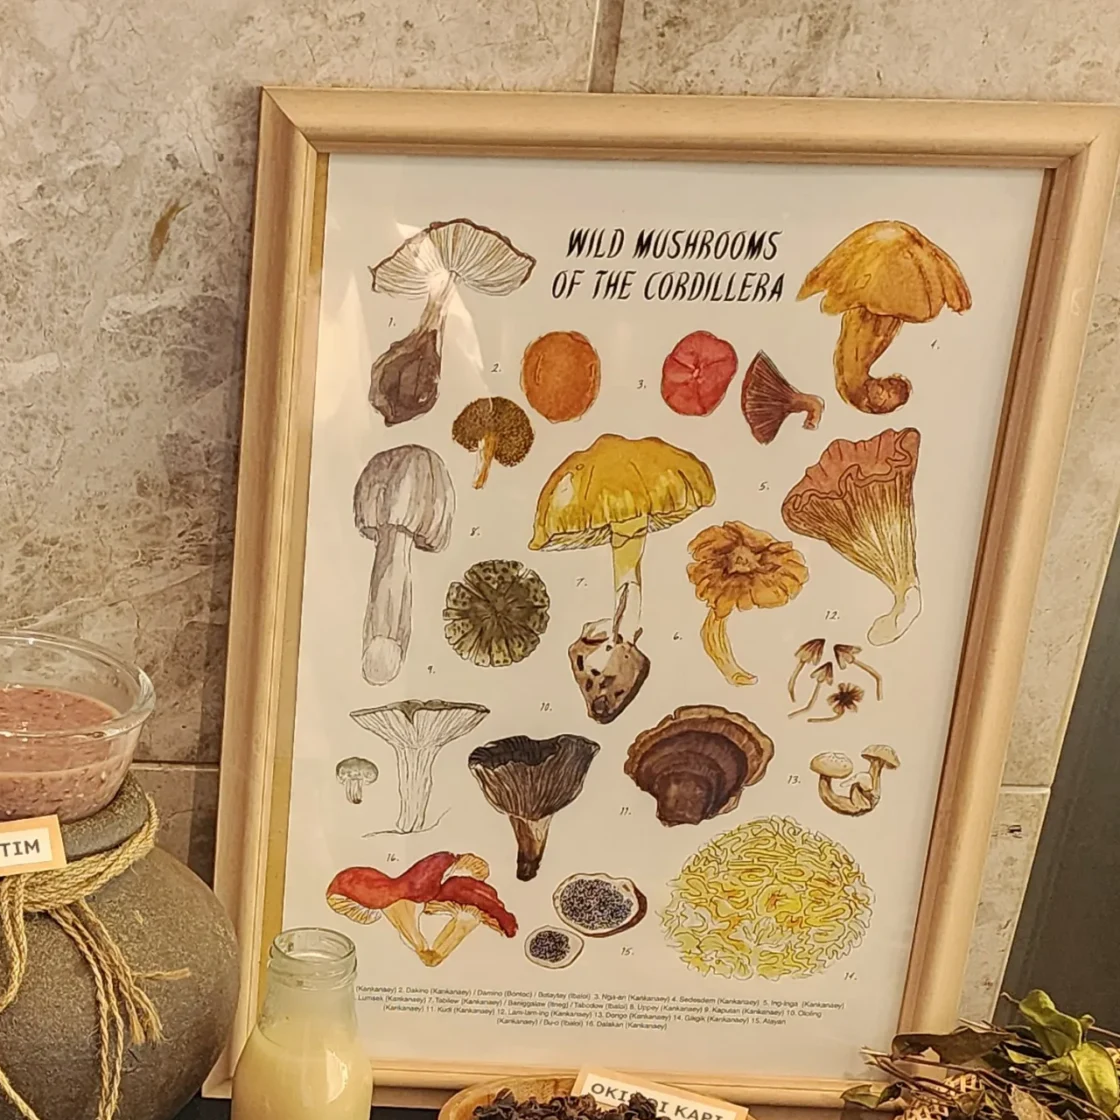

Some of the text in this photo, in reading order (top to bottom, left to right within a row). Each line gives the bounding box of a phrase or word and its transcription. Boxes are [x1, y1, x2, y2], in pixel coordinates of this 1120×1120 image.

[565, 228, 783, 261] WILD MUSHROOMS
[551, 270, 786, 303] OF THE CORDILLERA
[490, 363, 502, 374] 2.
[637, 379, 647, 390] 3.
[759, 481, 770, 492] 5.
[469, 525, 481, 537] 8.
[576, 577, 588, 588] 7.
[824, 610, 840, 621] 12.
[672, 631, 683, 642] 6.
[539, 702, 553, 713] 10.
[787, 774, 801, 785] 13.
[619, 806, 632, 817] 11.
[386, 852, 400, 863] 16.
[620, 946, 635, 957] 15.
[843, 971, 858, 982] 14.
